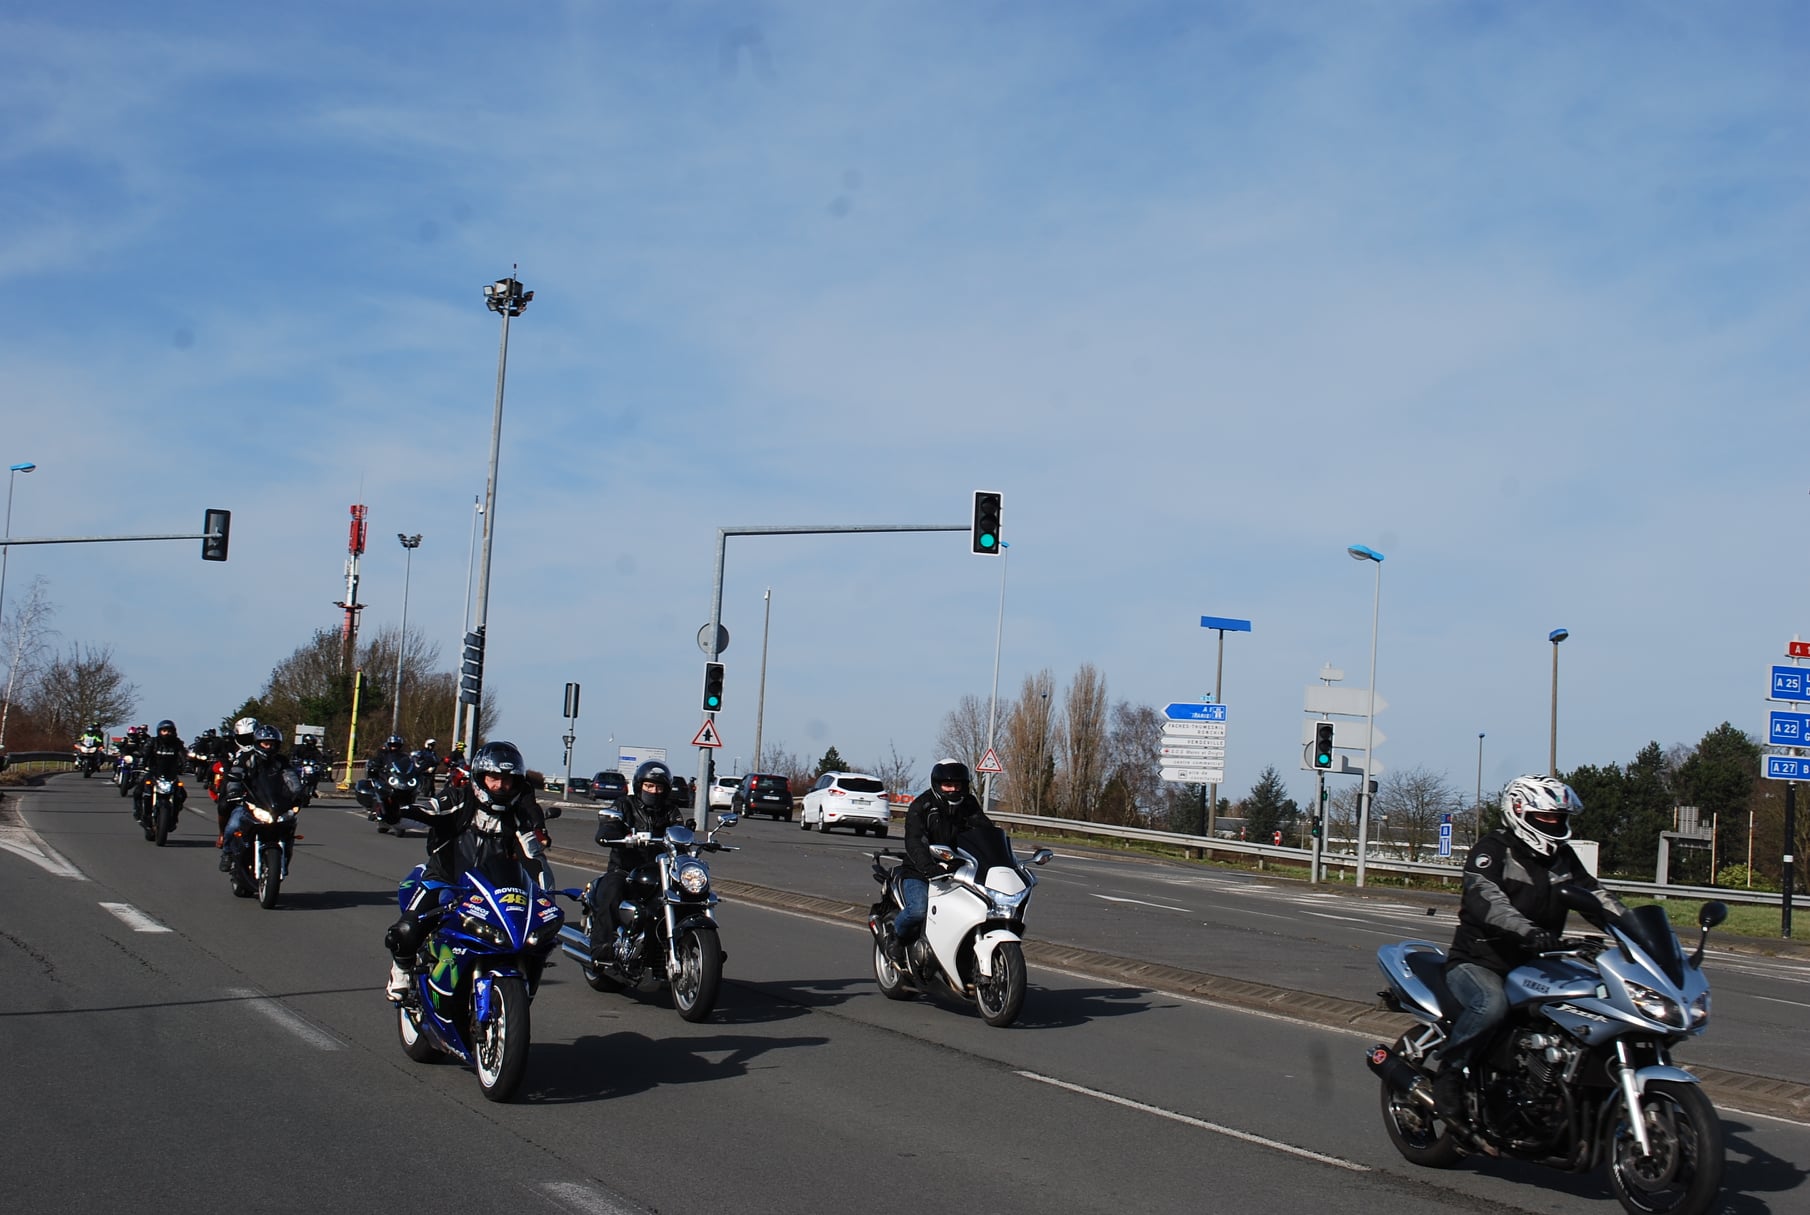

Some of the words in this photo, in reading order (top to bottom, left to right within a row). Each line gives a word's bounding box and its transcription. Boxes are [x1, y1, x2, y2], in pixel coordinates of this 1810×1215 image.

[1795, 644, 1801, 654] A
[1776, 678, 1783, 687] A
[1786, 678, 1798, 688] 25
[1775, 723, 1781, 733] A
[1784, 723, 1797, 734] 22
[1773, 763, 1780, 772] A
[1782, 763, 1795, 773] 27
[498, 893, 527, 906] 46
[1523, 979, 1550, 994] YAMAHA
